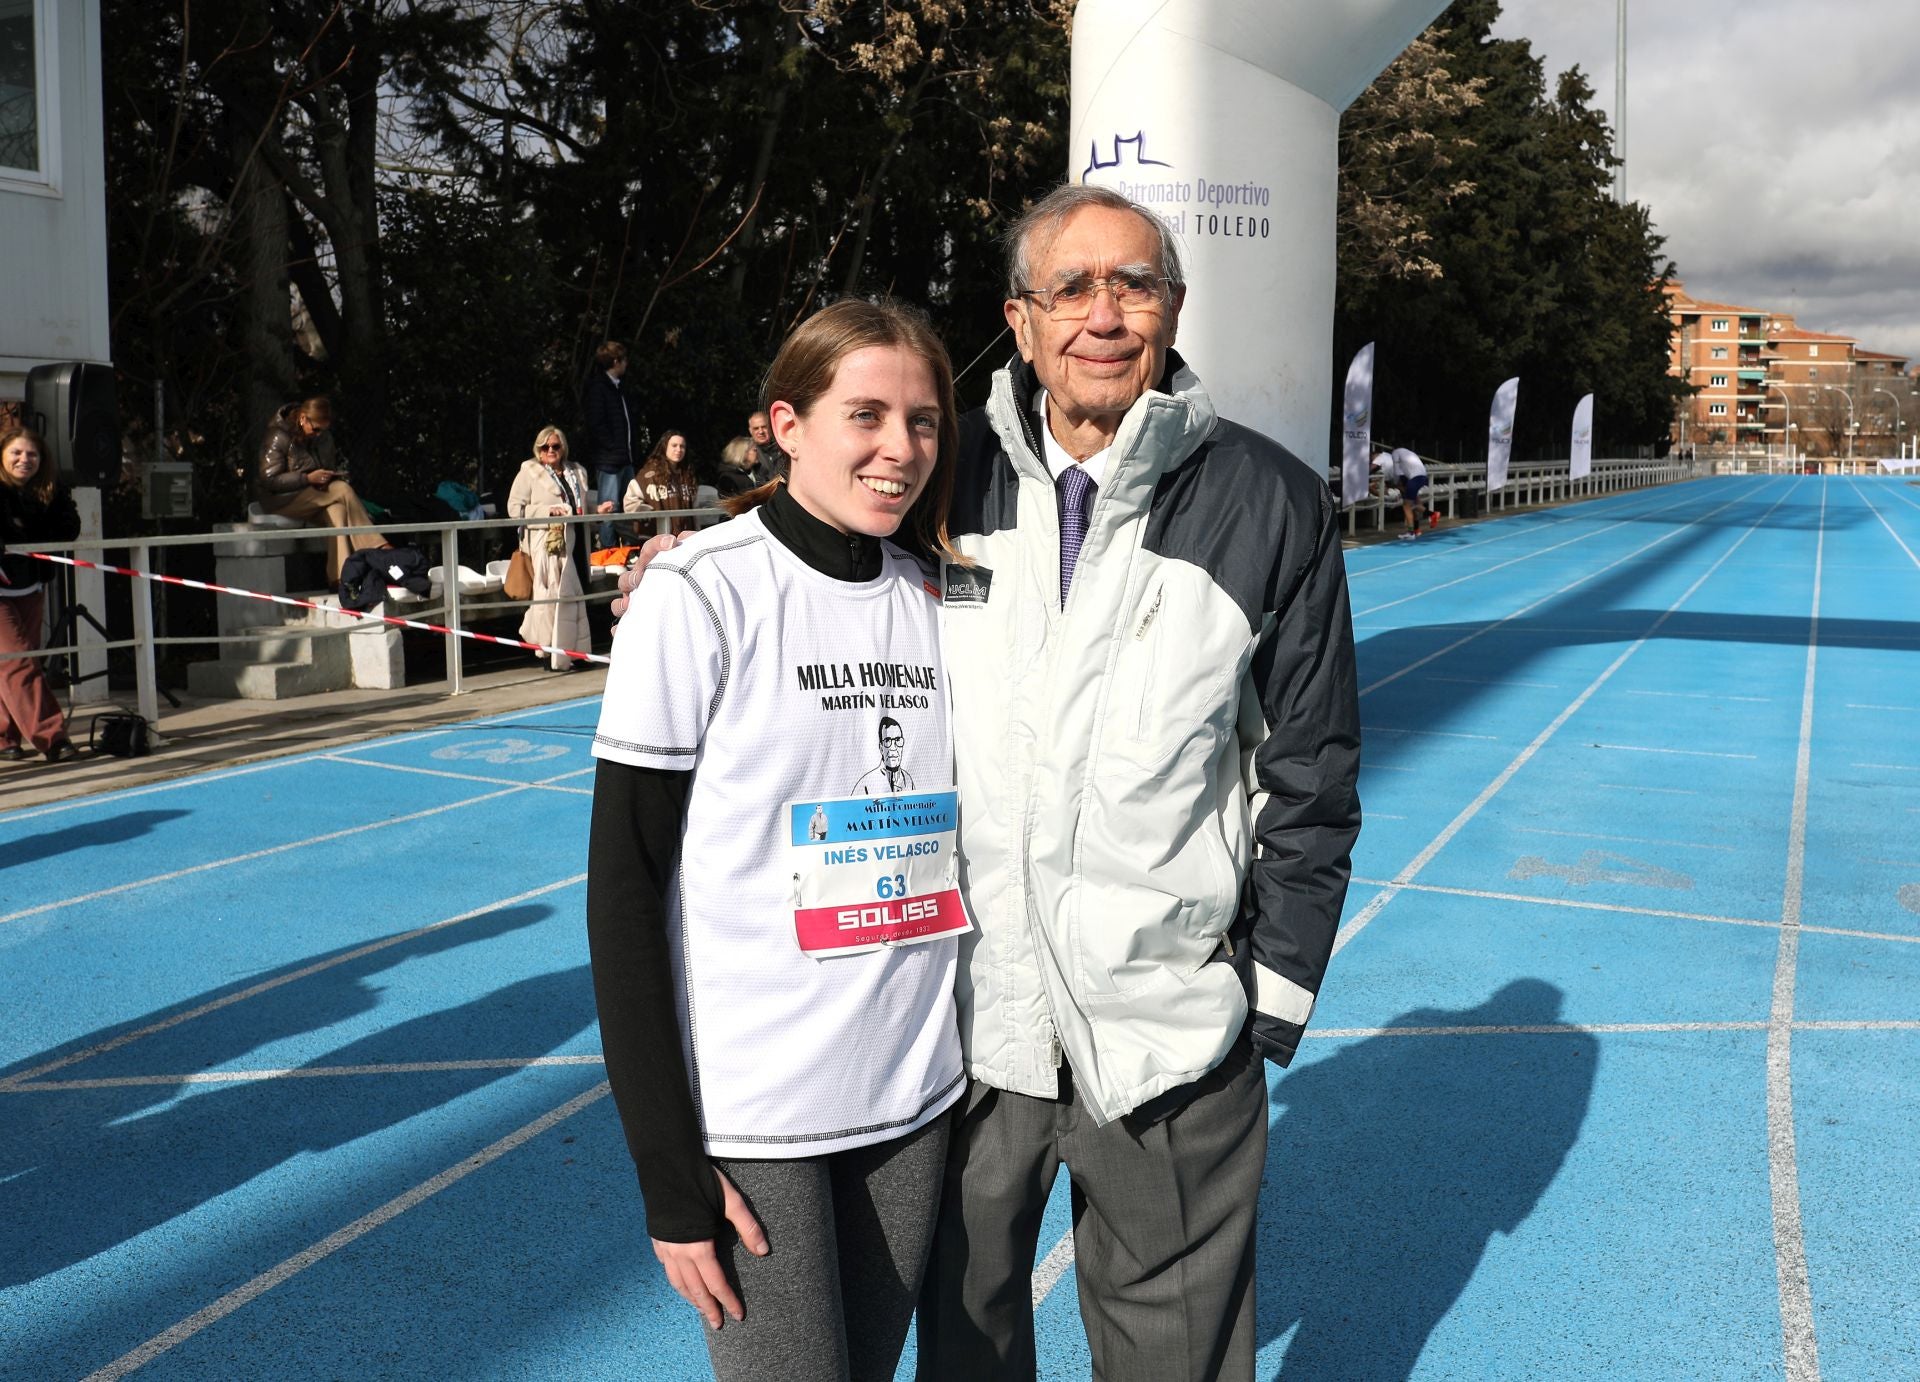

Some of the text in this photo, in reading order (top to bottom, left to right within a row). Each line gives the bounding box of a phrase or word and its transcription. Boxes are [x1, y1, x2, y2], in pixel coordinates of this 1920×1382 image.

[1119, 178, 1269, 208] Patronato Deportivo
[1195, 214, 1269, 239] TOLEDO
[796, 662, 937, 691] MILLA HOMENAJE
[822, 691, 929, 711] MARTÍN VELASCO
[846, 813, 949, 832] MARTÍN VELASCO
[824, 840, 939, 865] INÉS VELASCO
[876, 874, 906, 899] 63
[837, 899, 939, 931] SOLISS
